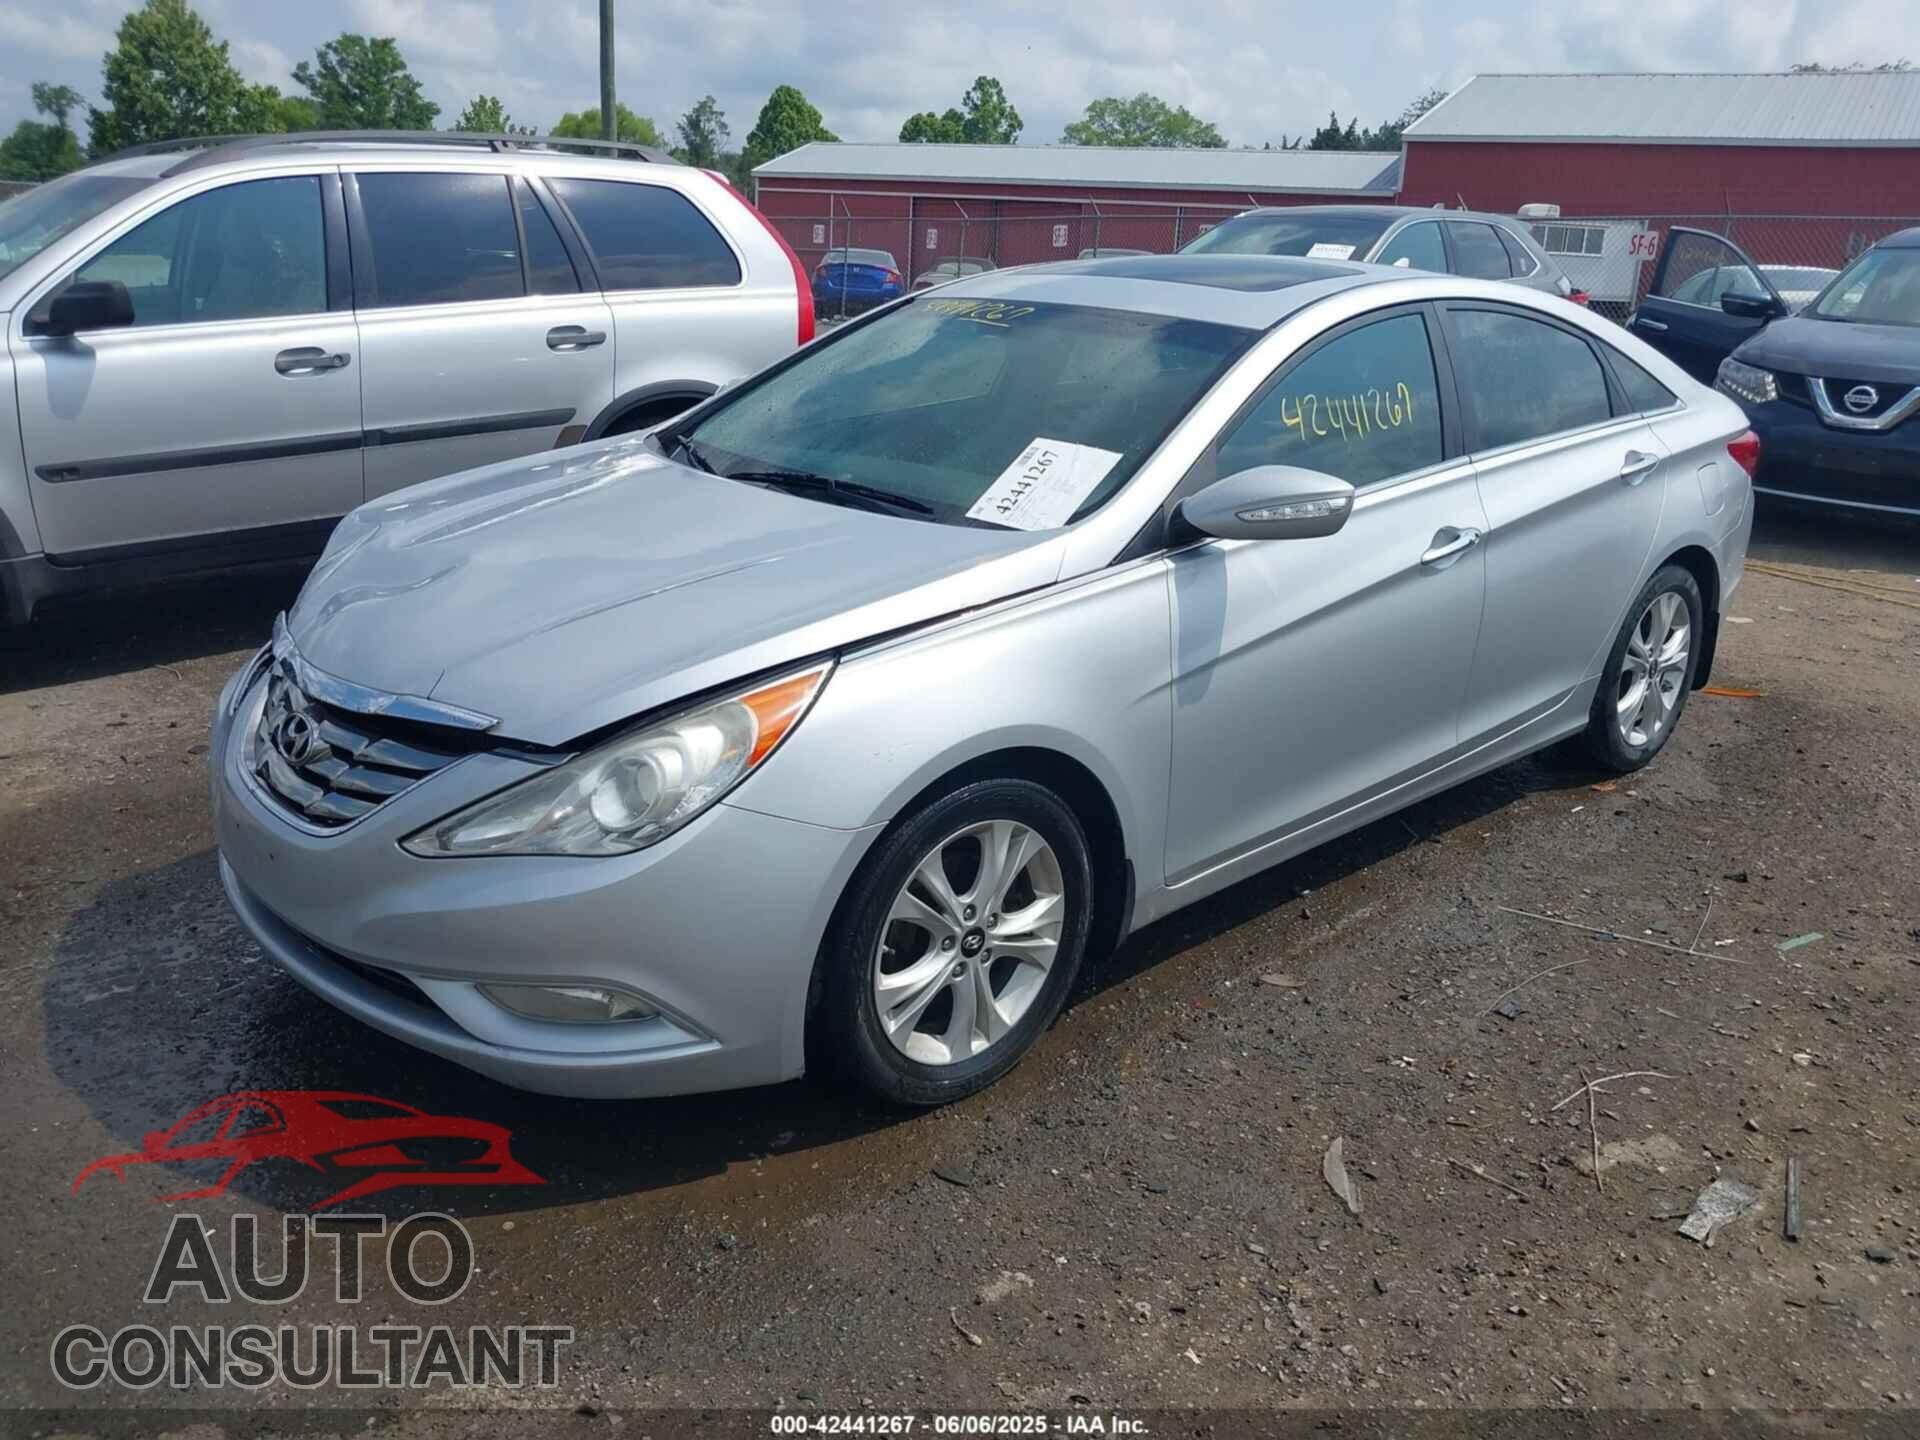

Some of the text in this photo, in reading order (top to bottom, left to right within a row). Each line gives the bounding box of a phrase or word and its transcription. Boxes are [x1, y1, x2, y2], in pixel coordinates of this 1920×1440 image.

[1629, 233, 1657, 256] SF-6
[1280, 382, 1413, 441] 42441267
[996, 450, 1059, 514] 42441267
